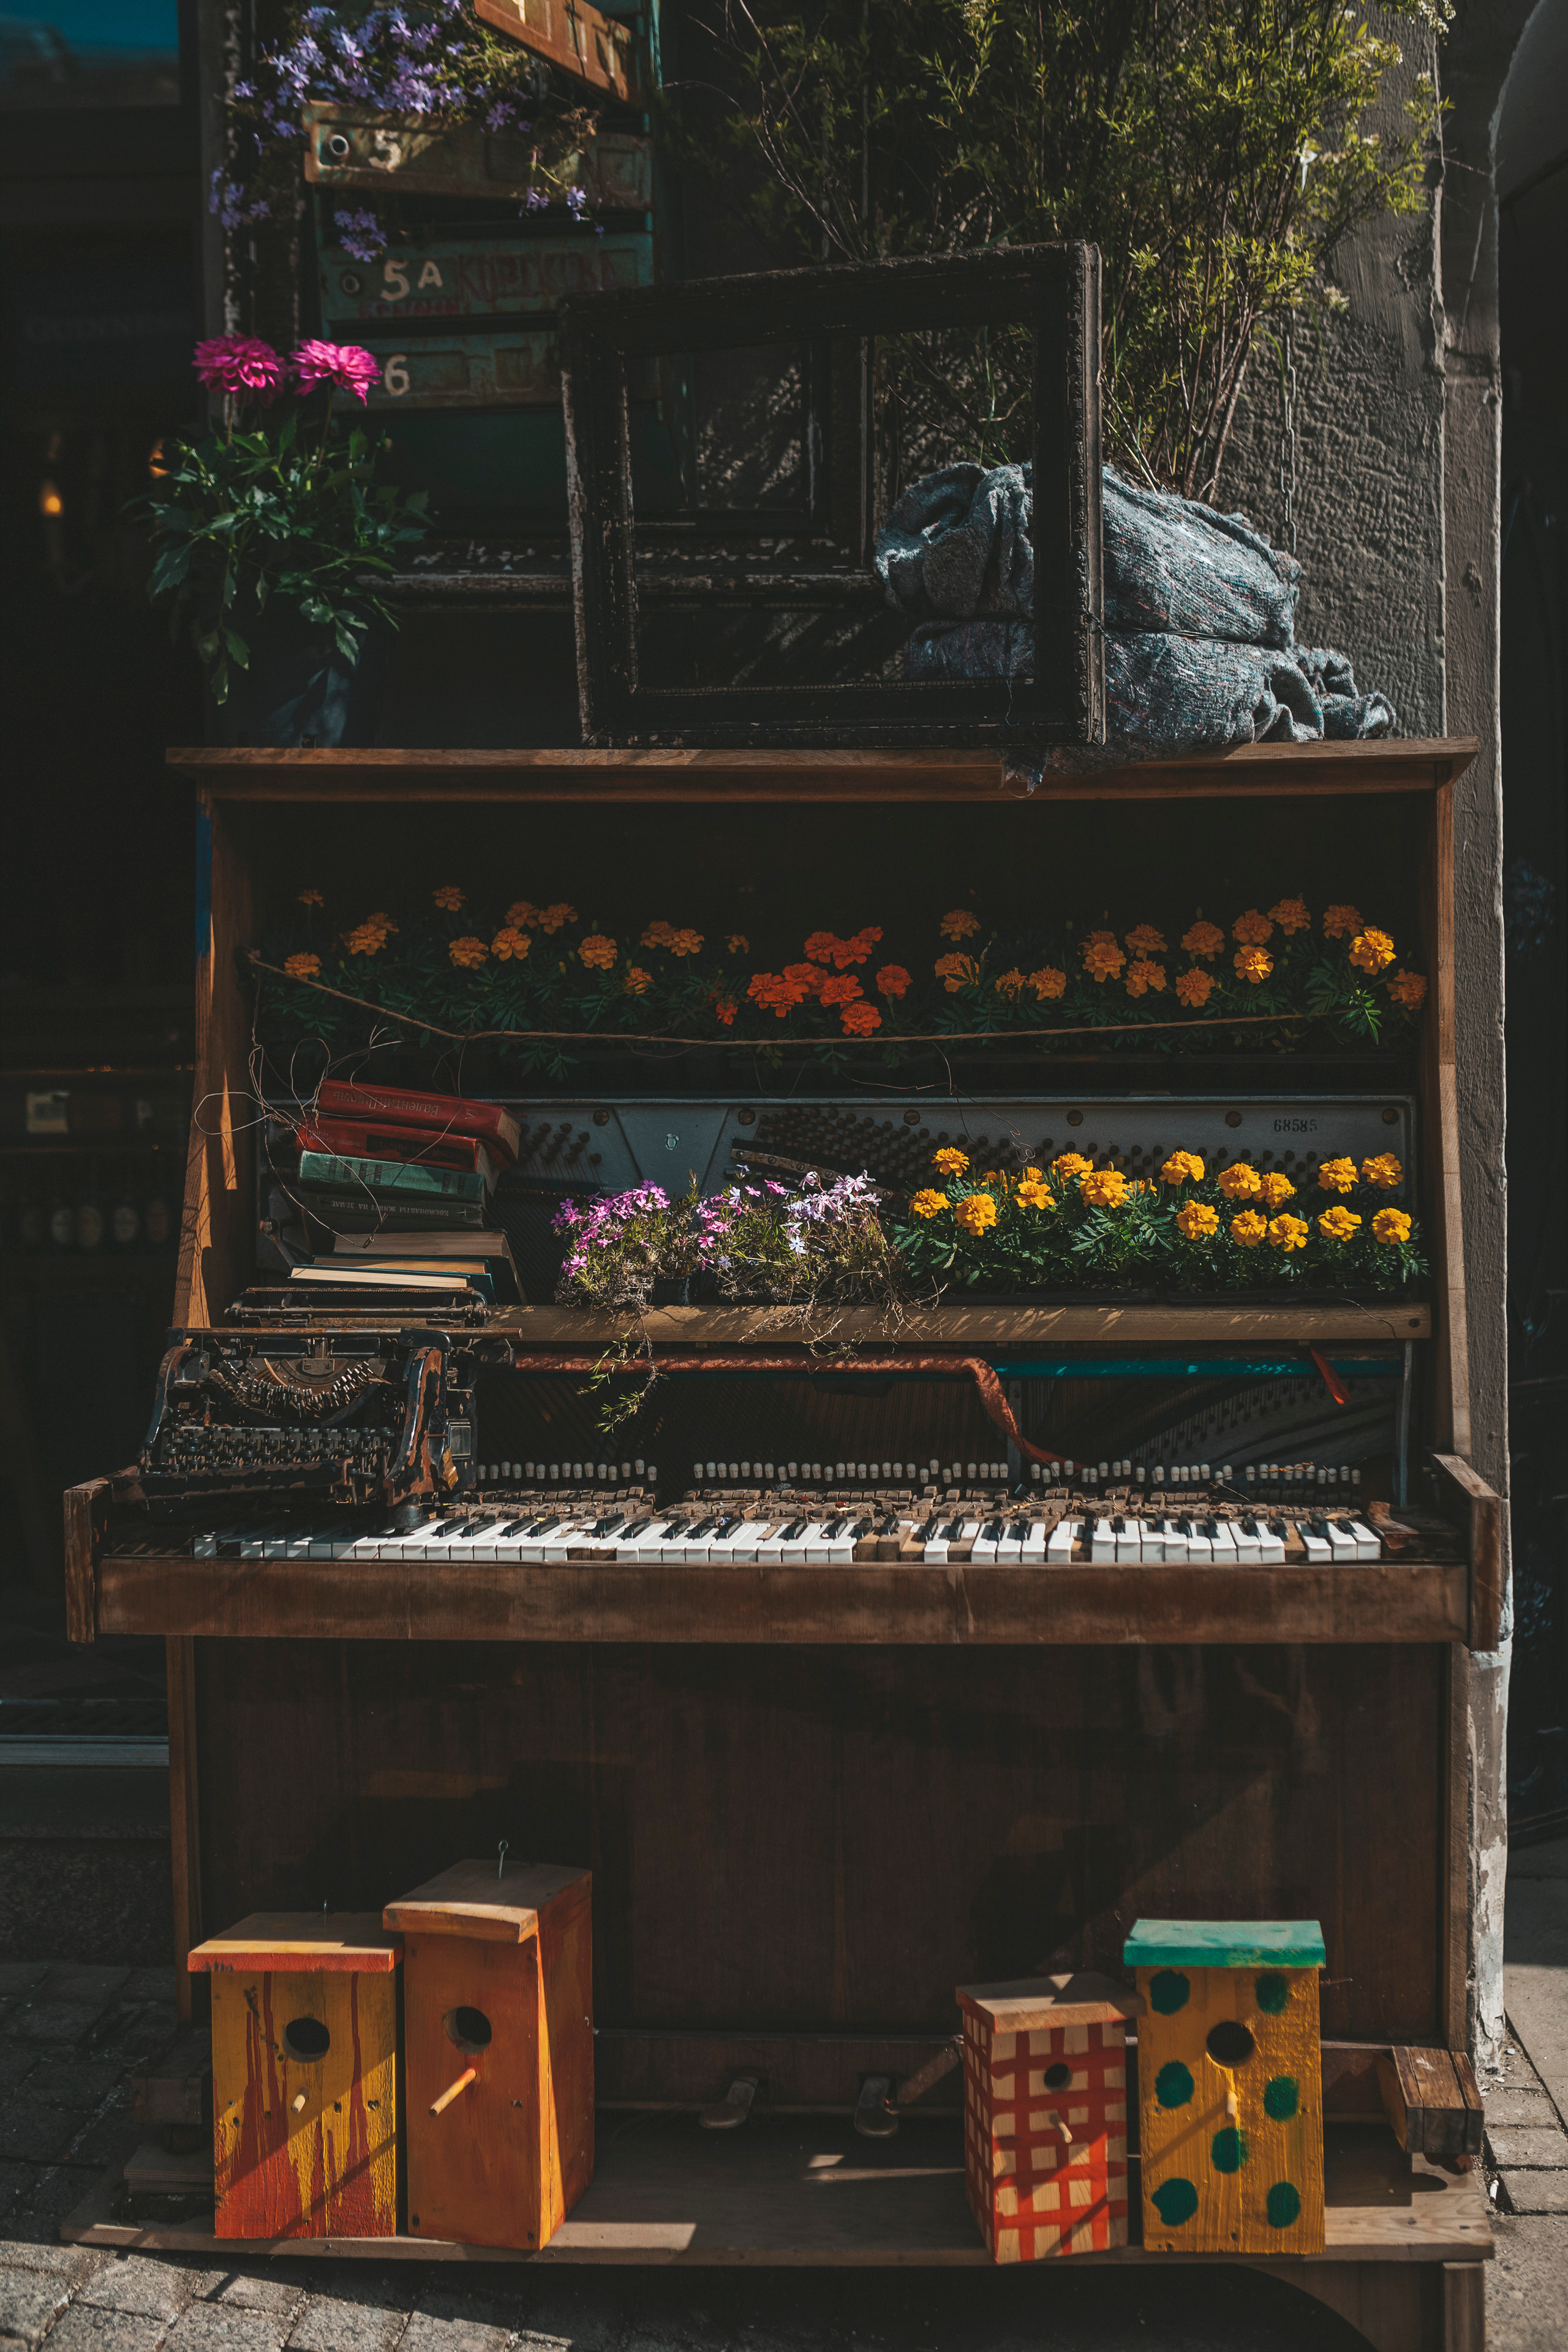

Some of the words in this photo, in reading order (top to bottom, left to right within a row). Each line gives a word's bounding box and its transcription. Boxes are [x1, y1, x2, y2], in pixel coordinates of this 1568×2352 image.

[369, 129, 401, 173] 5
[384, 354, 409, 396] 6
[379, 1099, 439, 1117] Валентин
[1274, 1119, 1317, 1132] 68585
[331, 1200, 355, 1209] ЗЕМЛЕ
[399, 1206, 449, 1216] КОСМОНАВТЫ
